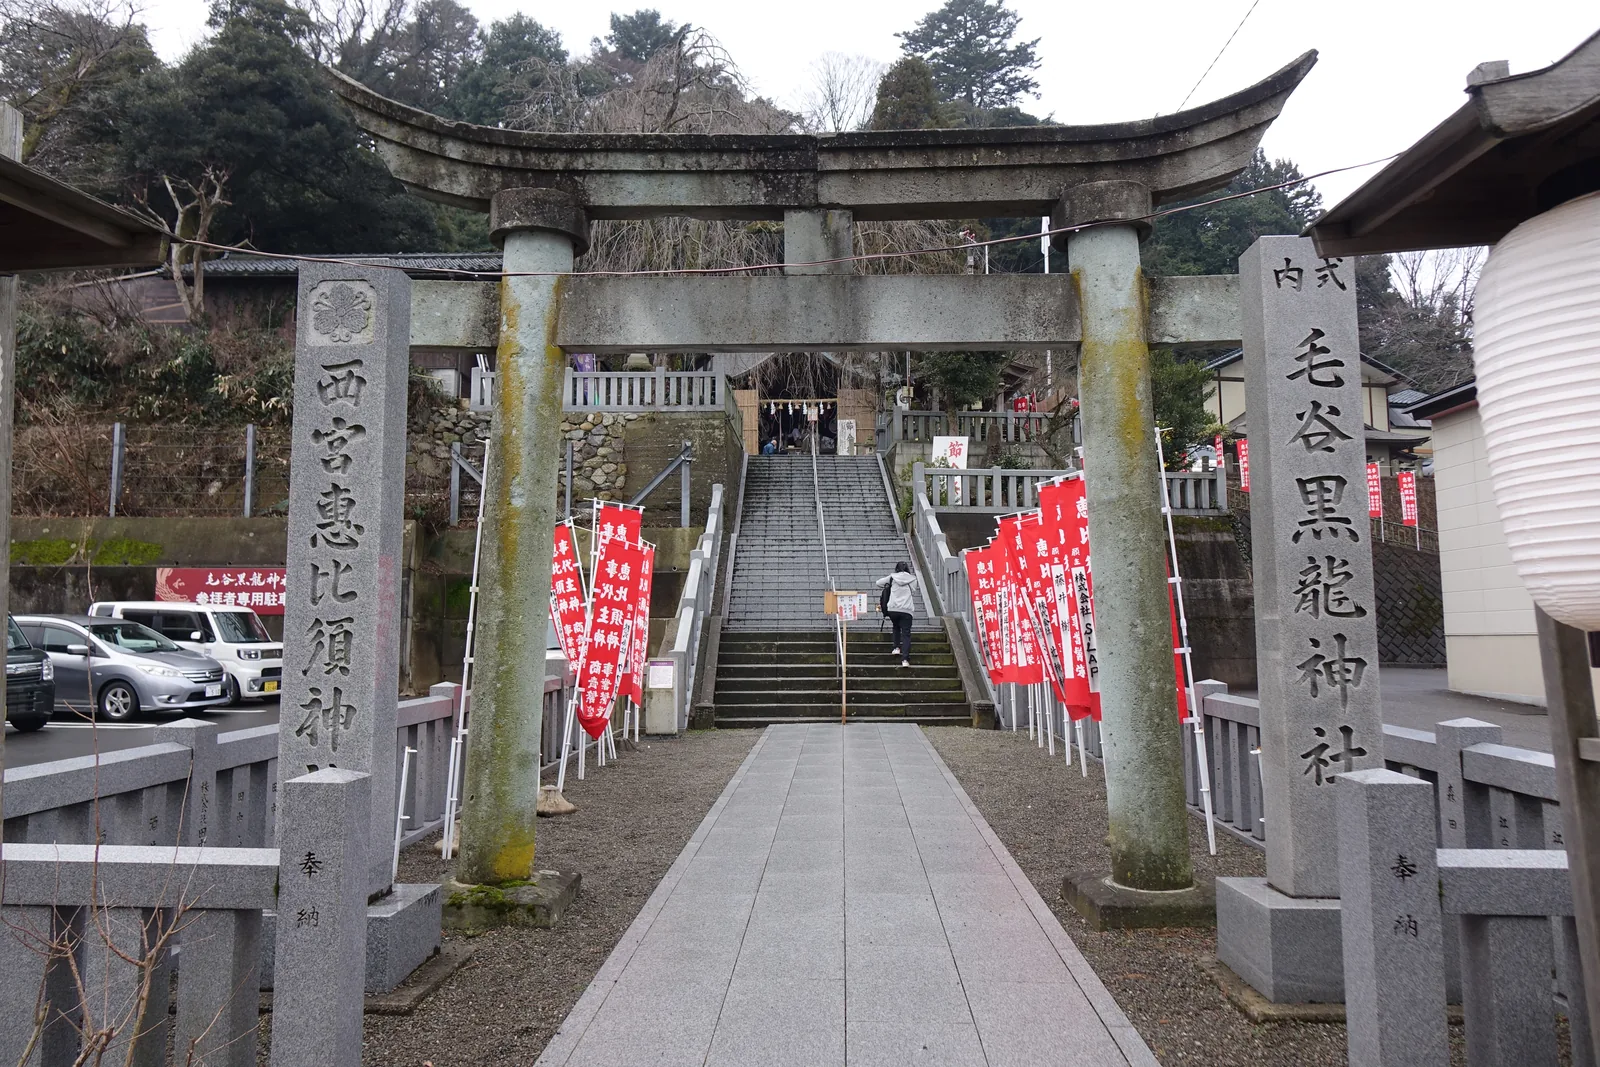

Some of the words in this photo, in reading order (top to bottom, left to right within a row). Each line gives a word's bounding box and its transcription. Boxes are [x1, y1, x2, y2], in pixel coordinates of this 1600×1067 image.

[295, 358, 367, 773] 西宮惠比須神
[1074, 572, 1091, 616] 株式会社
[1286, 328, 1368, 786] 毛谷黒龍神社
[297, 851, 322, 928] 奉納
[1391, 854, 1418, 938] 奉納
